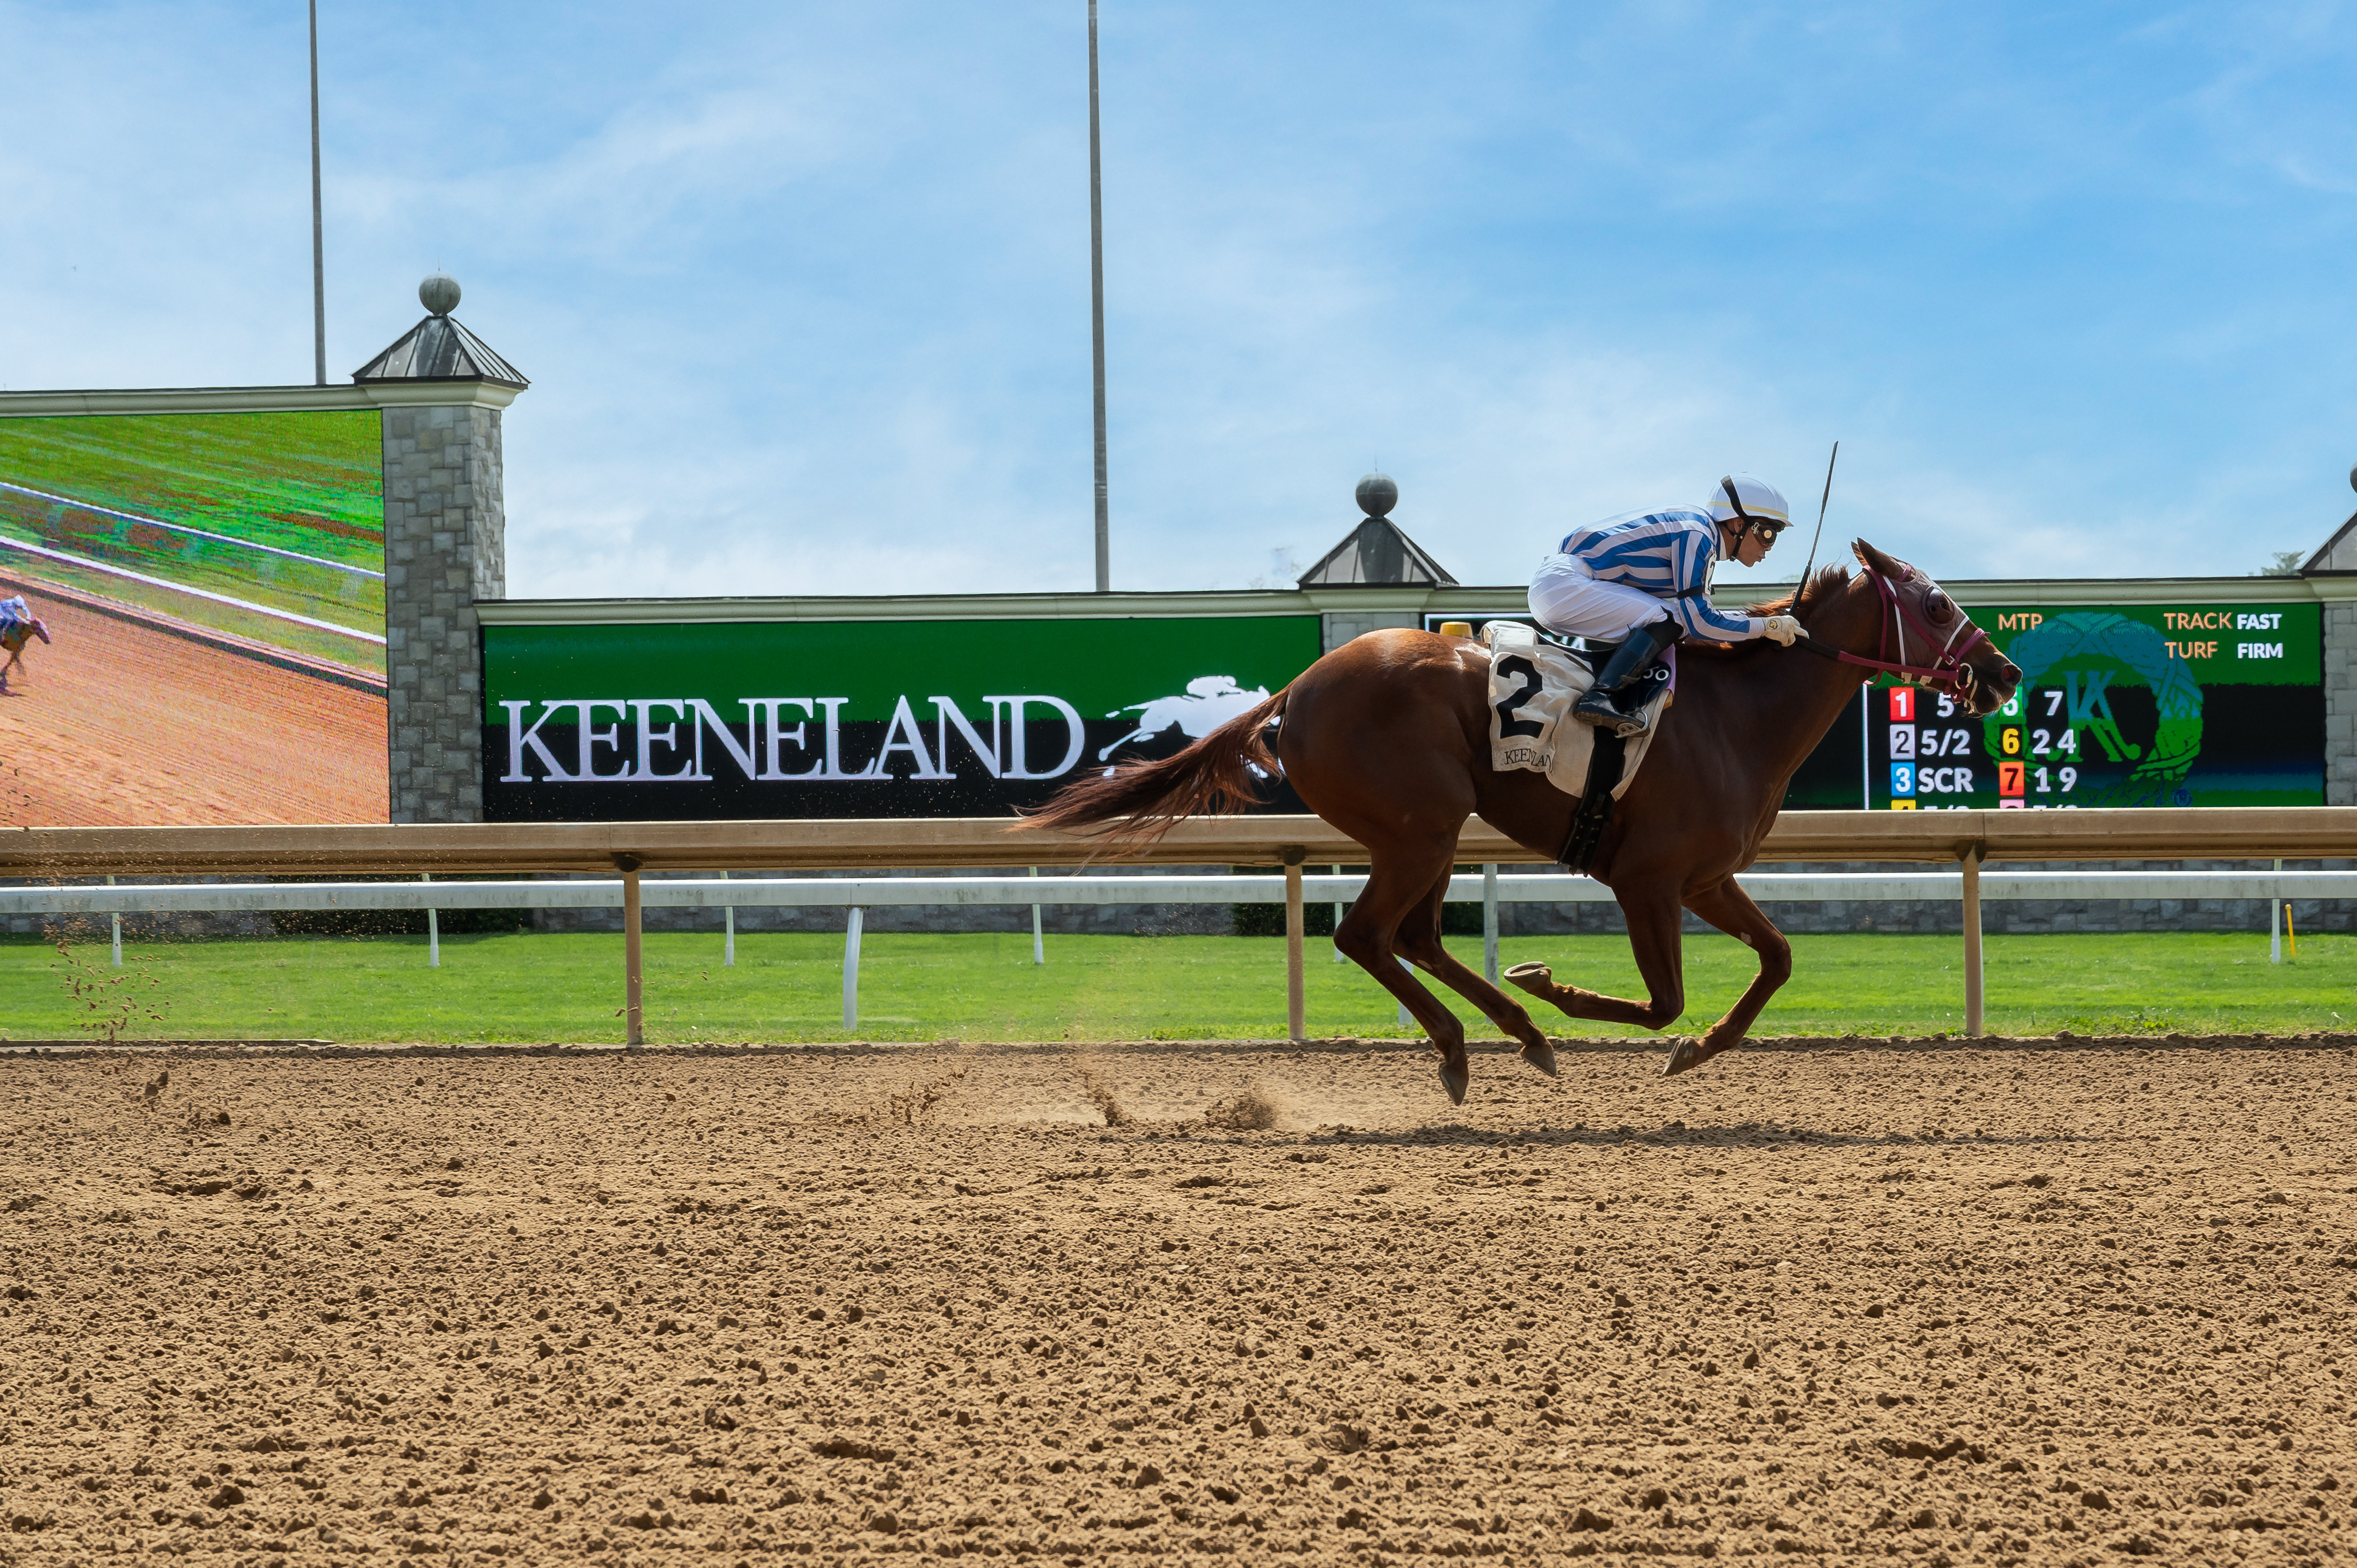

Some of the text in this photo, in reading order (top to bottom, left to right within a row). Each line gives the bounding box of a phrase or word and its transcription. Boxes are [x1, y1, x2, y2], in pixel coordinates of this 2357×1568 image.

[1998, 613, 2042, 630] MTP
[2163, 612, 2282, 629] TRACK FAST
[2164, 641, 2283, 659] TURF FIRM
[1496, 654, 1544, 739] 2
[1895, 692, 1954, 717] 1 5
[2044, 691, 2063, 716] 7
[499, 694, 1085, 782] KEENELAND
[1895, 729, 1970, 757] 2 5/2
[2003, 728, 2020, 754] 6
[1896, 767, 1974, 793] 3 SCR
[2004, 768, 2018, 791] 7
